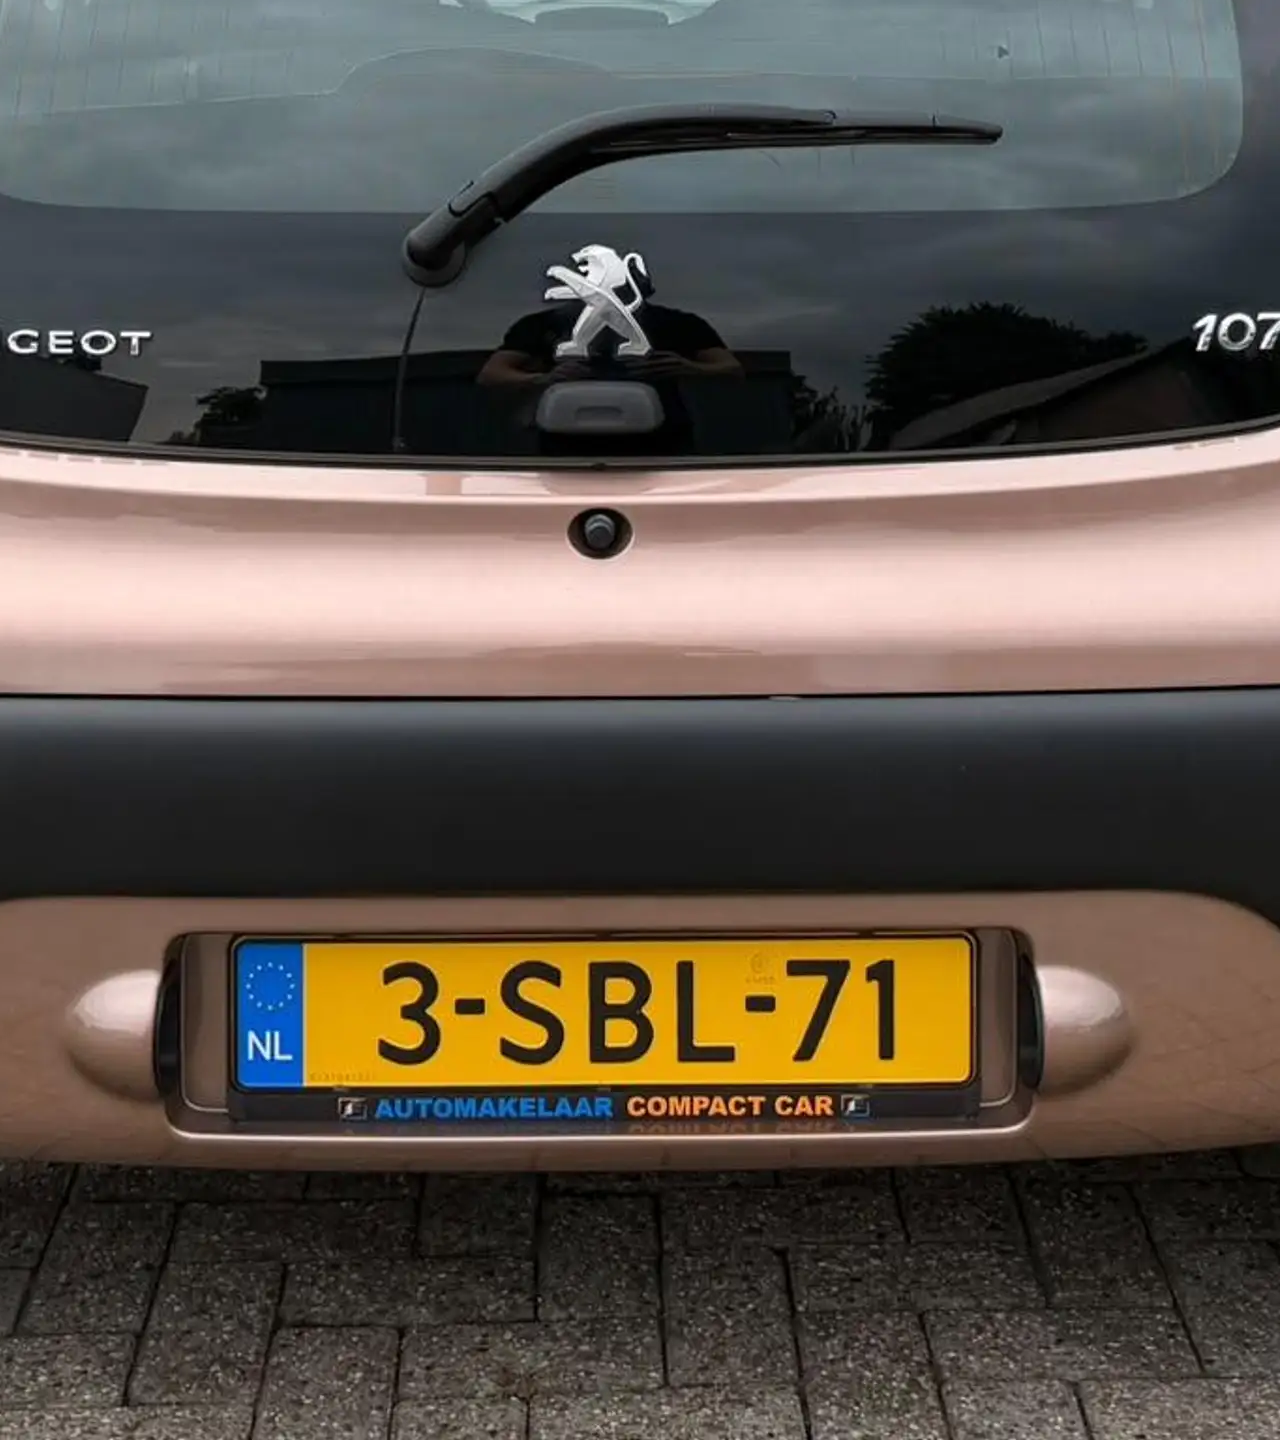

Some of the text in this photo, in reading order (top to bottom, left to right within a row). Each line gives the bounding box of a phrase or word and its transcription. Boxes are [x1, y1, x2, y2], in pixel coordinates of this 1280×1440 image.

[379, 960, 894, 1065] 3-SBL-71
[248, 1031, 293, 1060] NL
[376, 1095, 834, 1118] AUTOMAKELAAR COMPACT CAR
